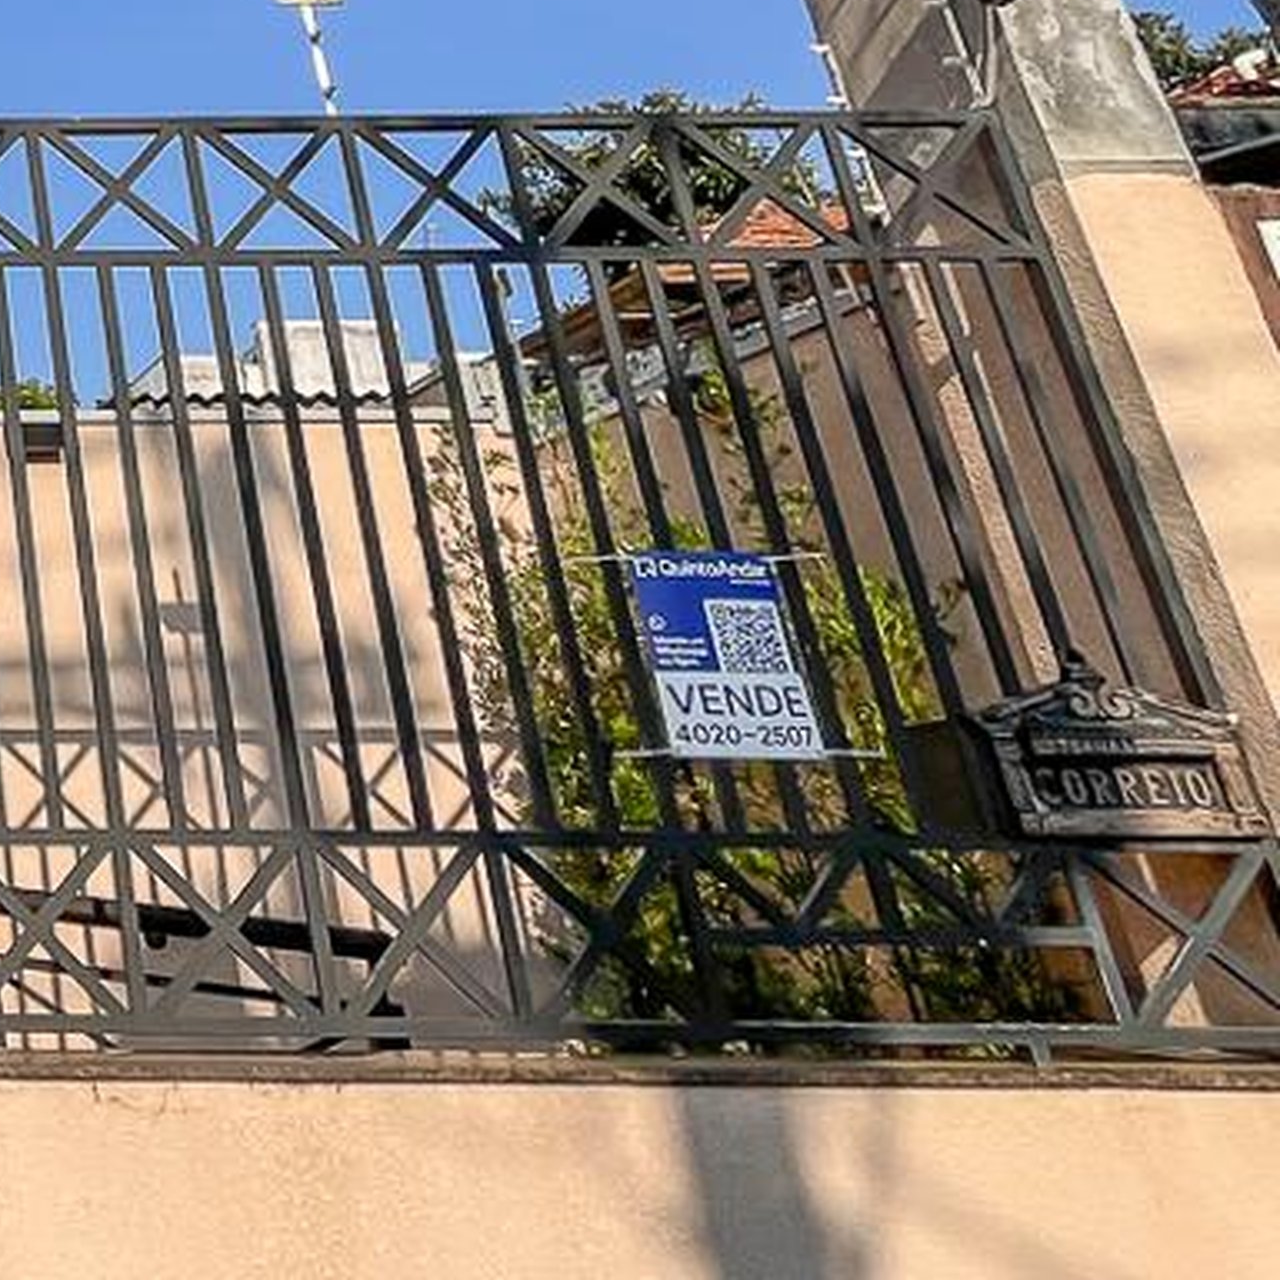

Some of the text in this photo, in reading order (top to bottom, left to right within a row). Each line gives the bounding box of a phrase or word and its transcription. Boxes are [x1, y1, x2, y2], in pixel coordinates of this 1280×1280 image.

[666, 683, 808, 718] VENDE
[676, 722, 813, 748] 4020-2507
[1036, 767, 1212, 807] CORREIO
